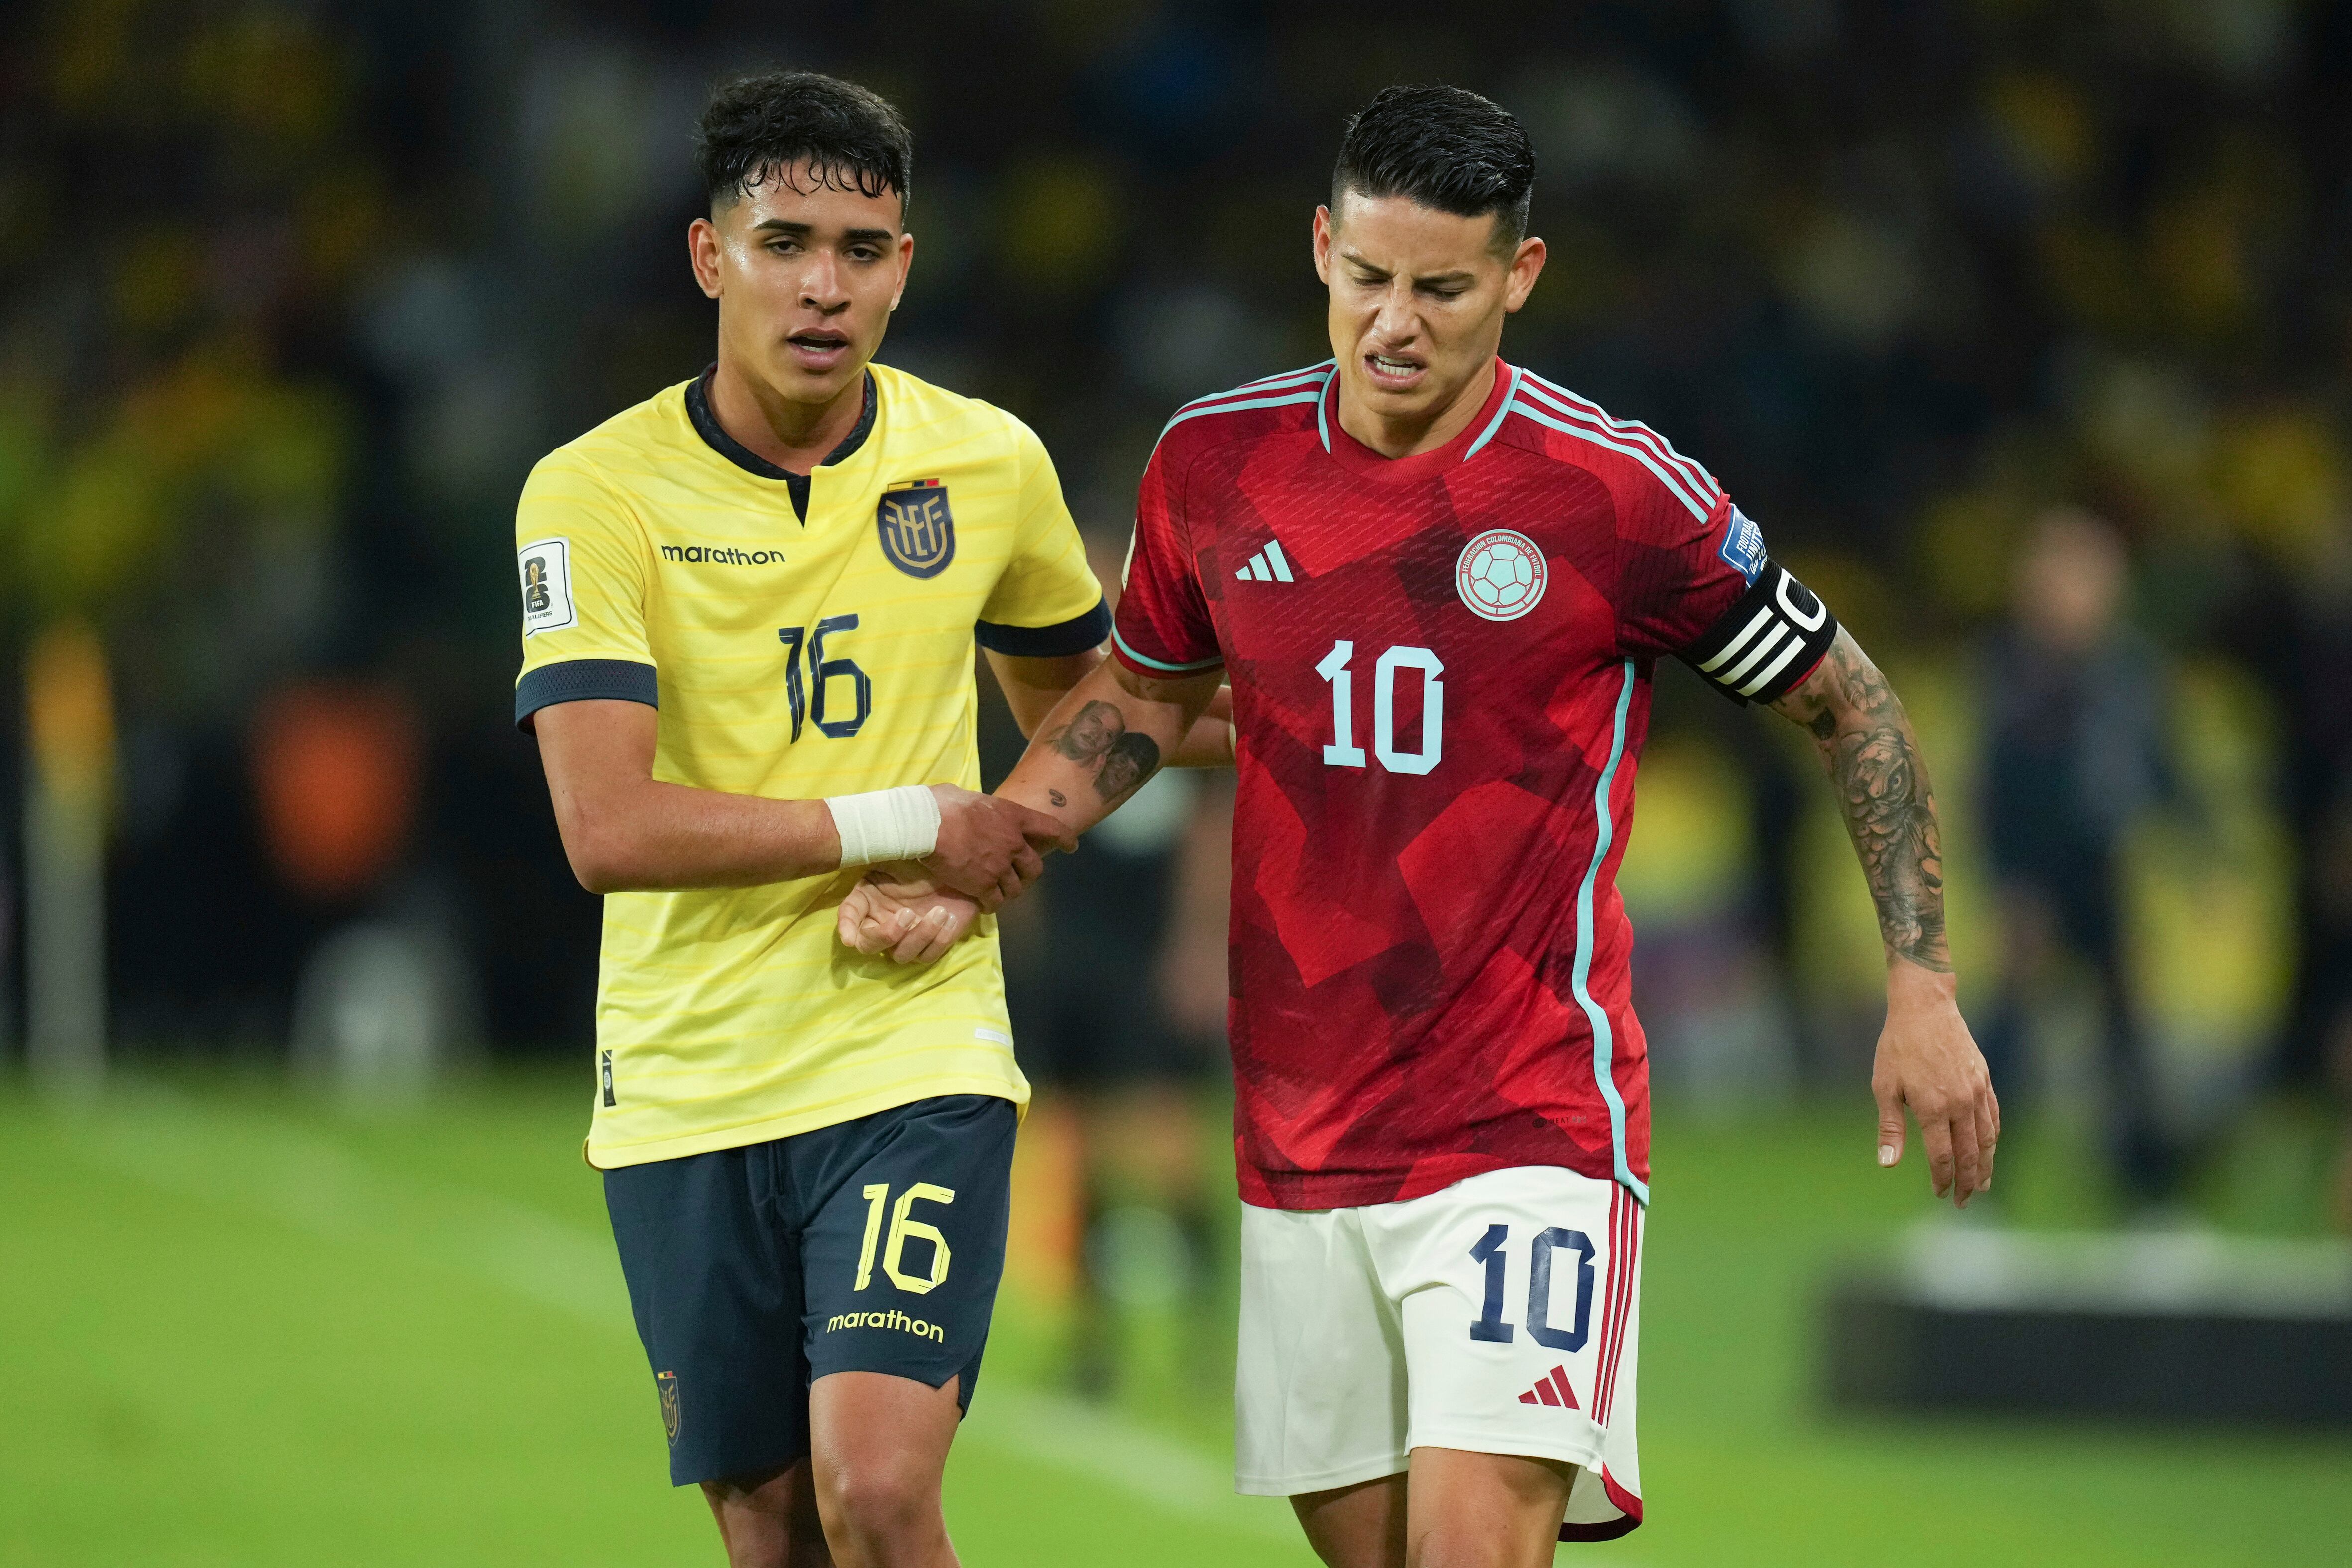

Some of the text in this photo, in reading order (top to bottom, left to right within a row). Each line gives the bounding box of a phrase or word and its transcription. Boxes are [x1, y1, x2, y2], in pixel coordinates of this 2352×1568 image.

[661, 545, 785, 565] marathon
[1462, 535, 1542, 577] FEDERACION COLOMBIANA DE FUTBOL
[1746, 523, 1763, 560] UNITE
[531, 599, 544, 608] FIFA
[779, 613, 871, 745] 16
[1315, 640, 1445, 775] 10
[854, 1182, 955, 1295] 16
[1469, 1224, 1595, 1353] 10
[827, 1309, 944, 1343] marathon
